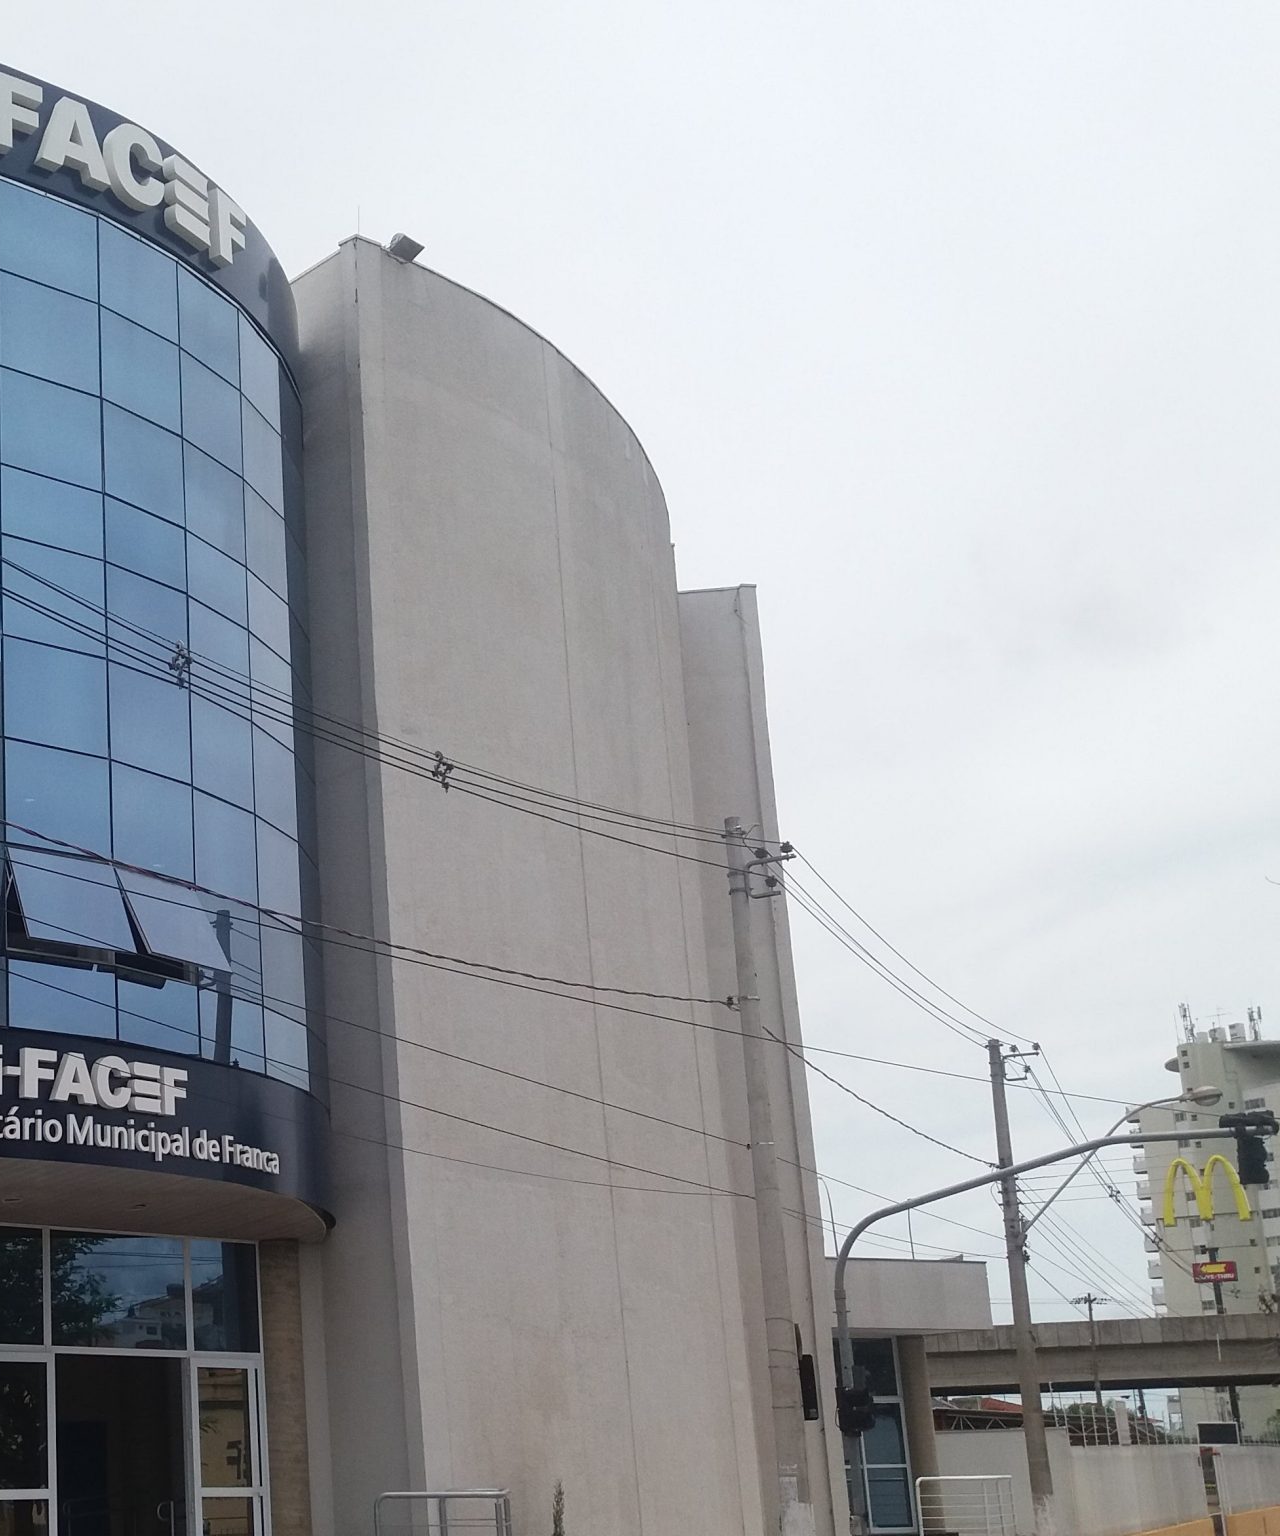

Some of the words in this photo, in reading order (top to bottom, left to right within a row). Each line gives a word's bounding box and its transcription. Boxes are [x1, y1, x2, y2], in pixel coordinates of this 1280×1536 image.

[67, 1114, 190, 1161] Municipal
[192, 1129, 220, 1161] de
[221, 1135, 279, 1174] Franca
